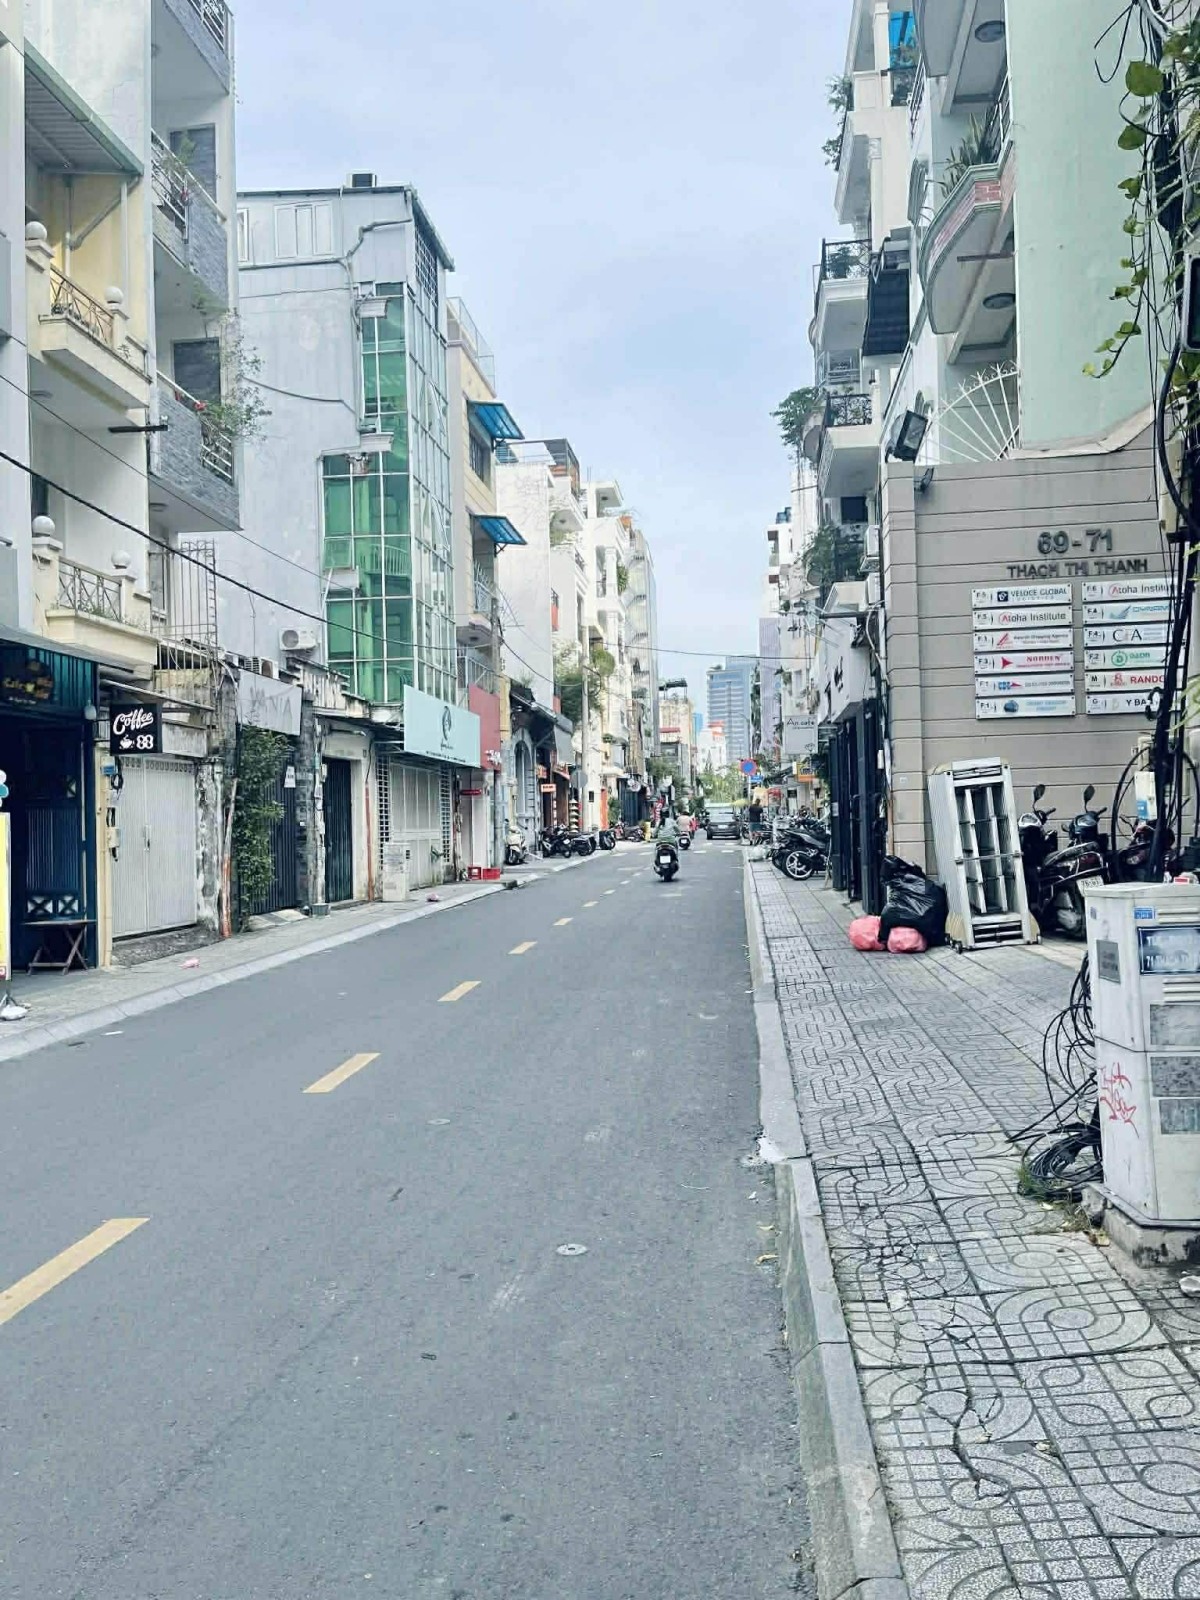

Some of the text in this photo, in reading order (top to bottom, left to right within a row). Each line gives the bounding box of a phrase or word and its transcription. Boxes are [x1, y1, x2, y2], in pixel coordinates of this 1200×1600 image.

[1094, 558, 1148, 575] THANH
[1030, 612, 1067, 621] Institute
[113, 708, 154, 735] Coffee
[136, 734, 154, 749] 88
